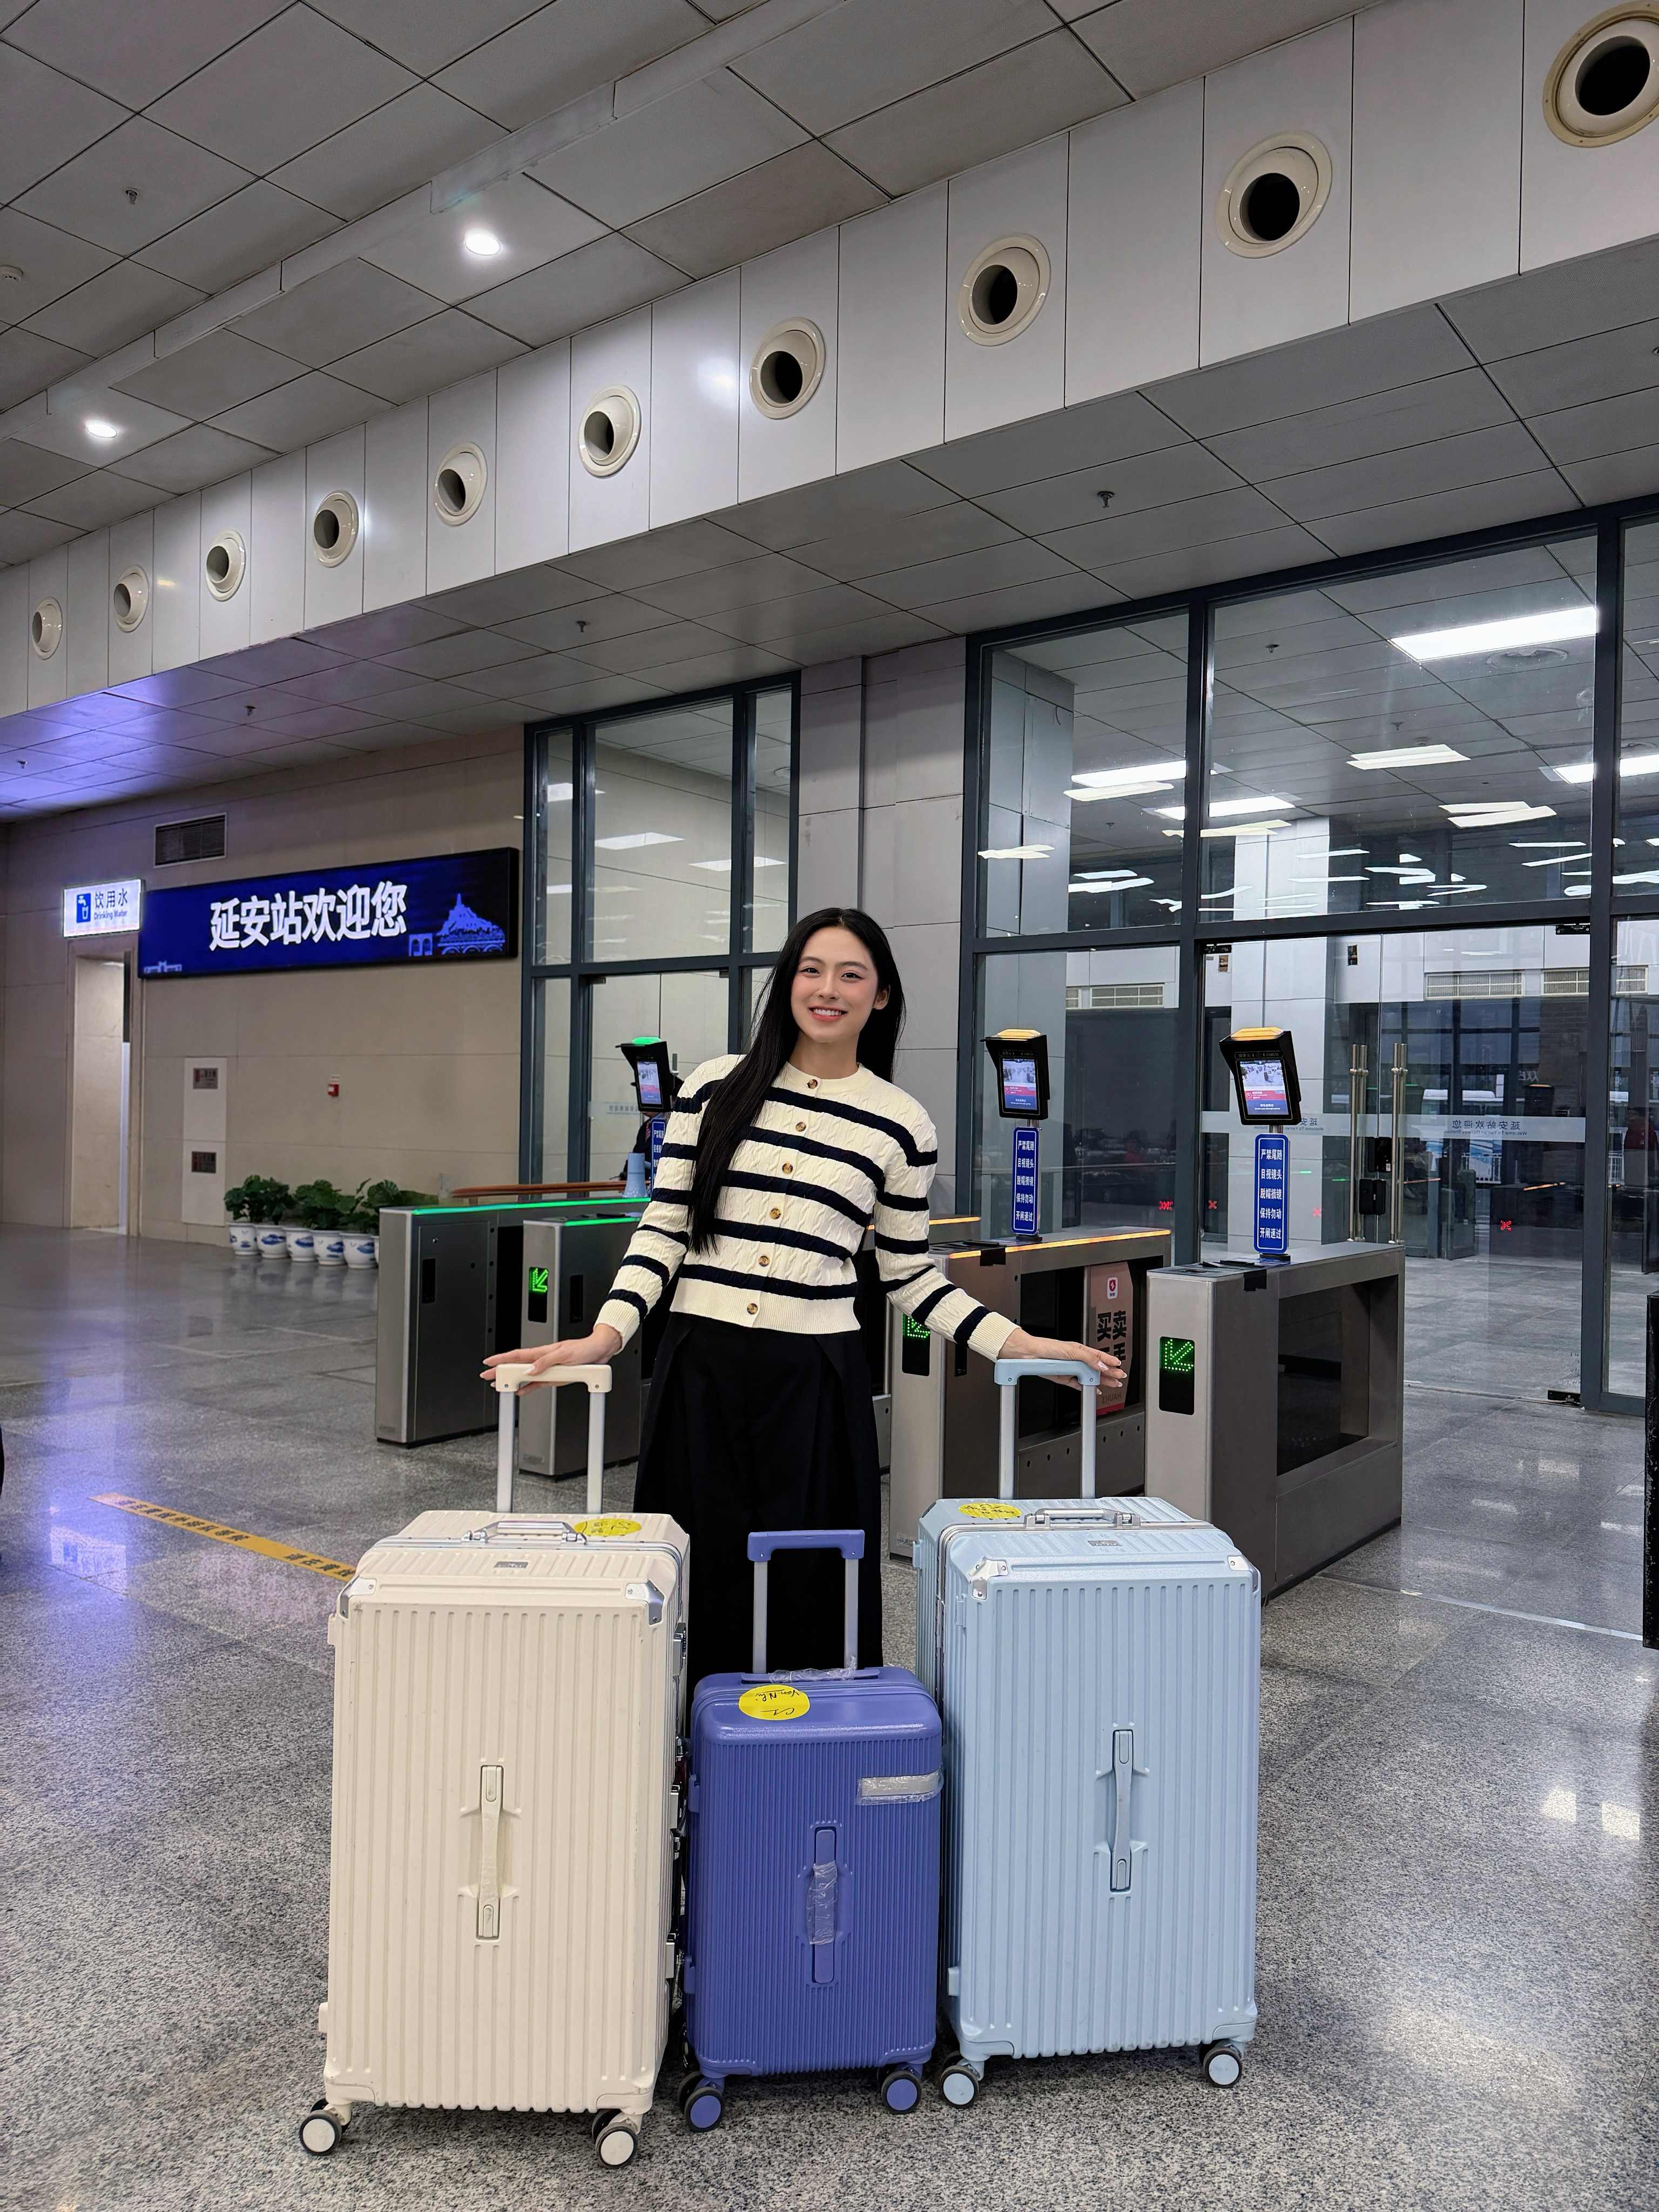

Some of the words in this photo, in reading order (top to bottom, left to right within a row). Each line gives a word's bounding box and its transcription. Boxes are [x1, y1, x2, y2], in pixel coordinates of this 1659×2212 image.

[95, 888, 128, 909] 饮用水
[94, 911, 113, 920] Drinking
[209, 881, 407, 951] 延安站欢迎您
[1260, 1149, 1283, 1160] 严禁尾随
[1261, 1169, 1282, 1180] 目视镜头
[1260, 1188, 1282, 1199] 脱帽摘镜
[1260, 1208, 1282, 1219] 保持勿动
[1259, 1227, 1282, 1239] 开闸速过
[1097, 1310, 1127, 1342] 买卖
